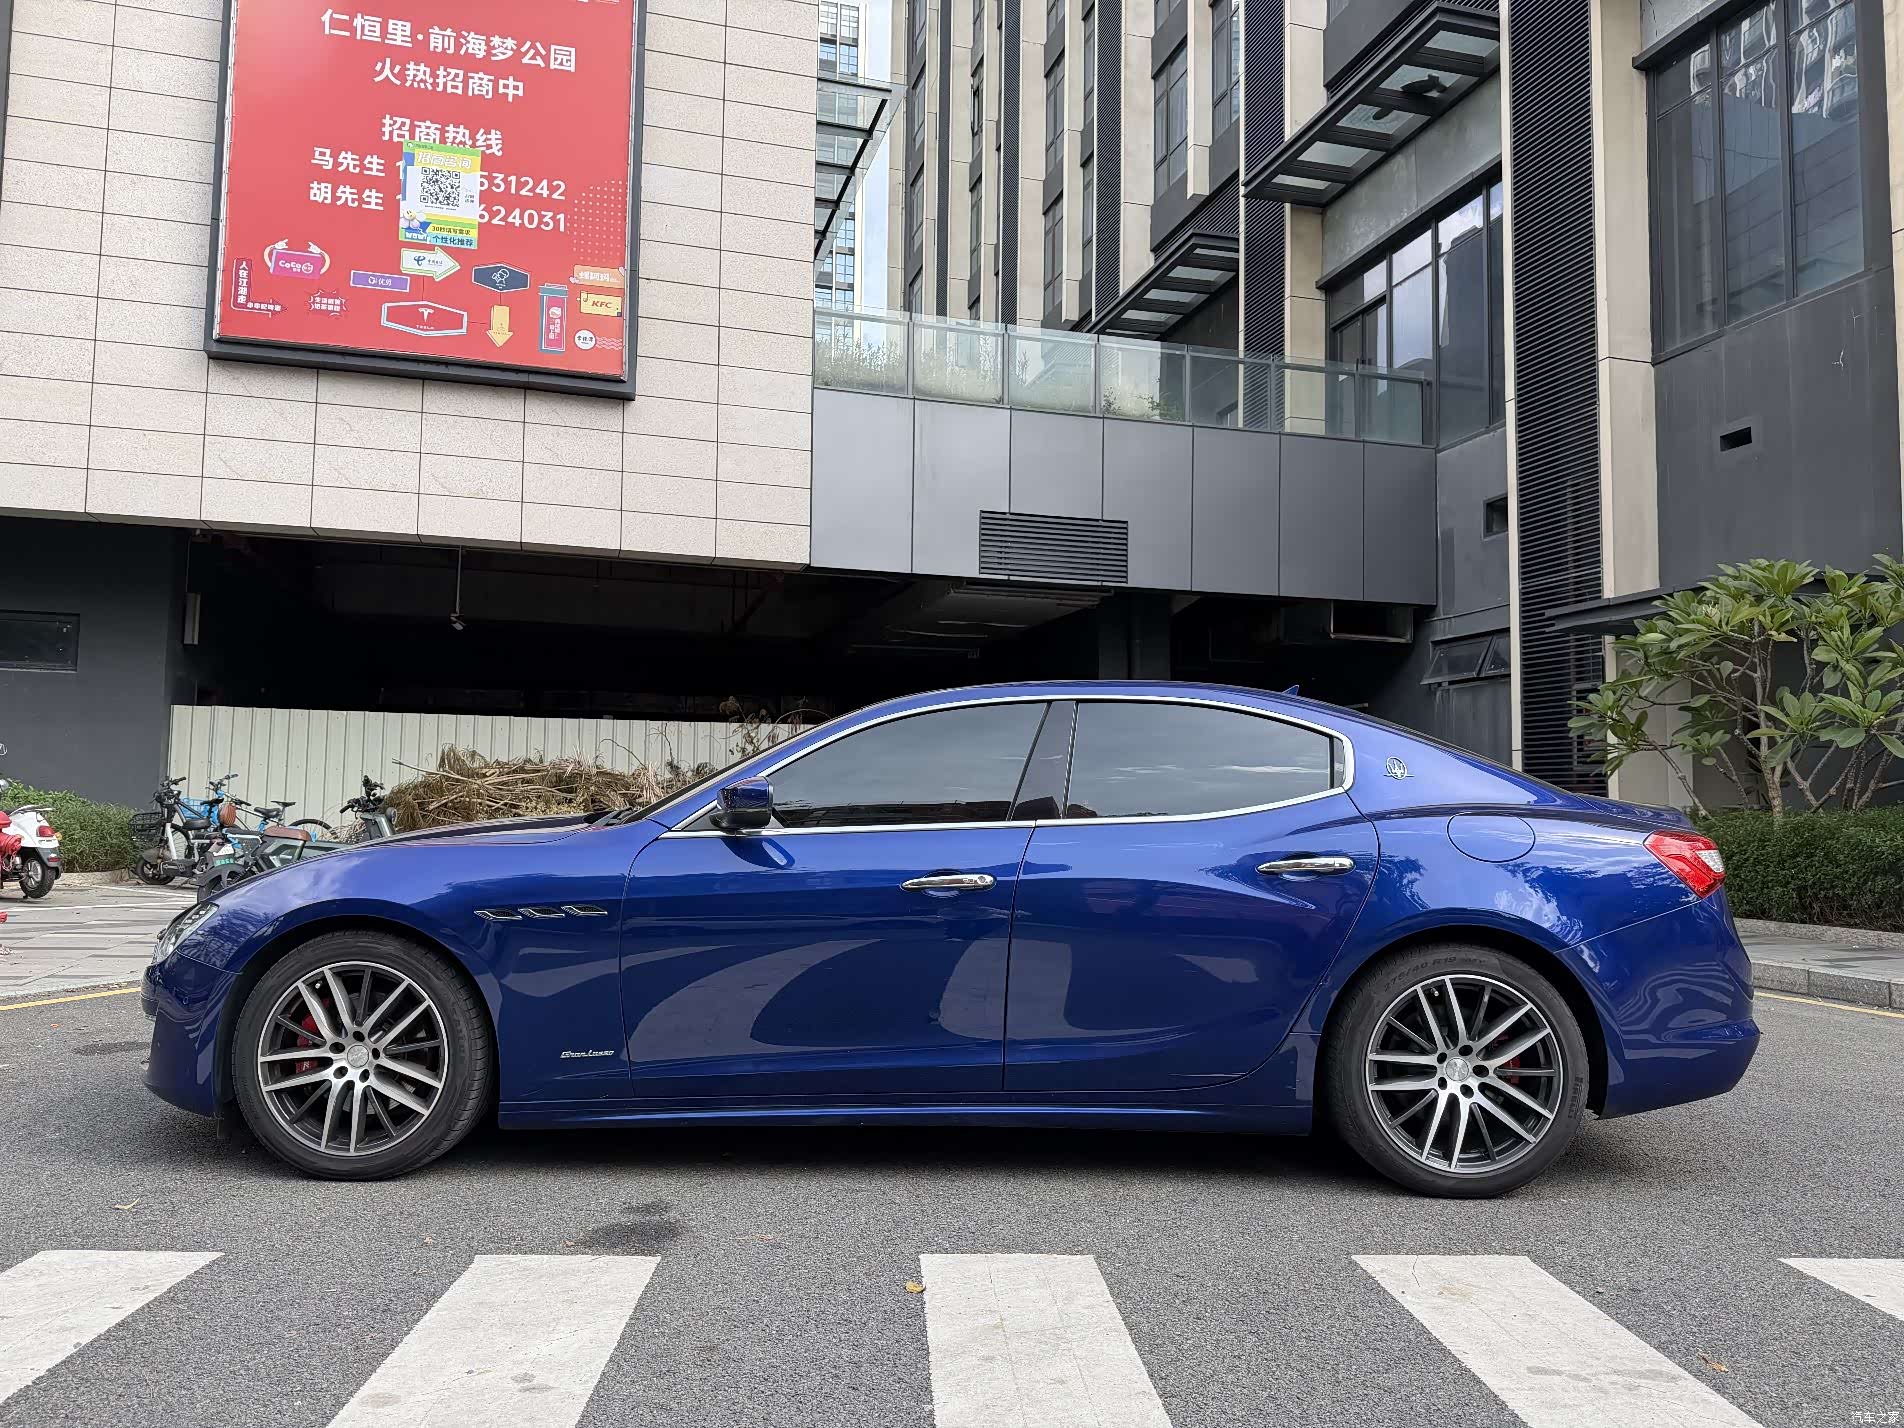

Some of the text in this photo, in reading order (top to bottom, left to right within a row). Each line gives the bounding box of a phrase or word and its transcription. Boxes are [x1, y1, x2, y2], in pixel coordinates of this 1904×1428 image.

[320, 8, 577, 73] 仁恒里·前海梦公园
[373, 57, 525, 103] 火热招商中
[381, 114, 504, 157] 招商热线
[310, 146, 387, 177] 马先生
[309, 180, 385, 211] 胡先生
[432, 234, 474, 247] 个性化推荐
[237, 260, 249, 304] 人在江湖走
[591, 300, 613, 309] KFC
